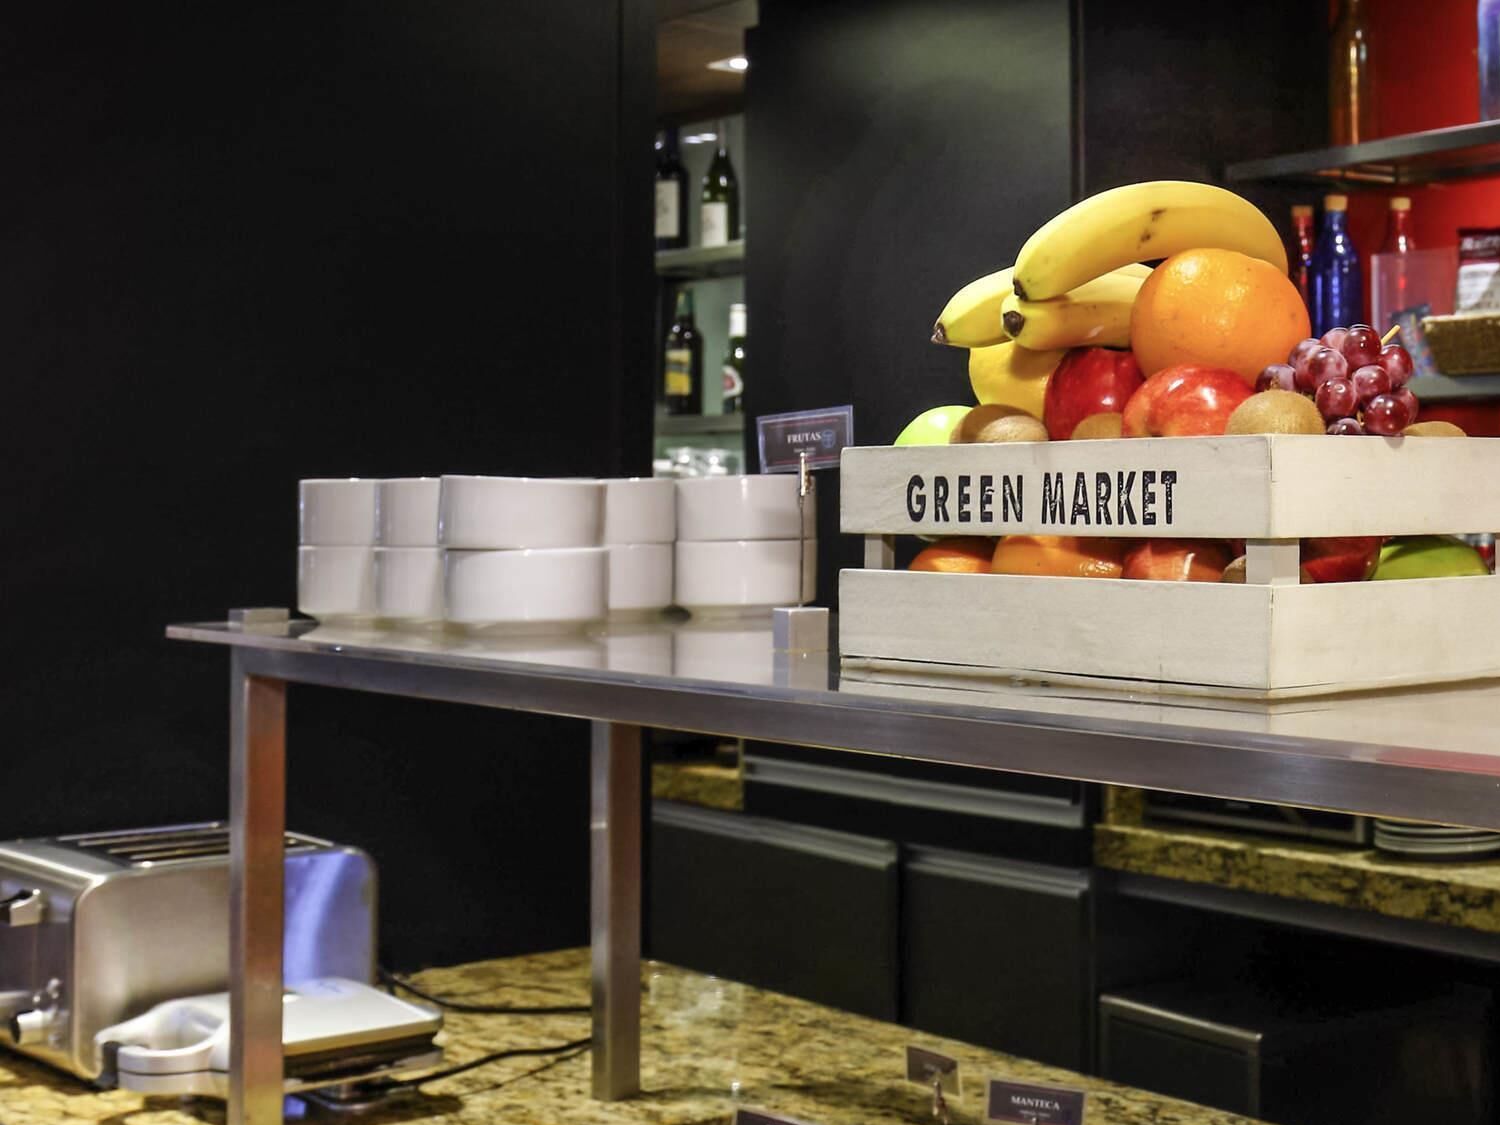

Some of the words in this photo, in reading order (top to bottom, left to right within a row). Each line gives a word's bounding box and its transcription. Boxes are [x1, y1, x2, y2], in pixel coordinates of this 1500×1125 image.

[787, 432, 821, 443] FRUTAS
[907, 475, 1023, 522] GREEN
[1041, 471, 1177, 525] MARKET
[1010, 1095, 1060, 1110] MANTECA
